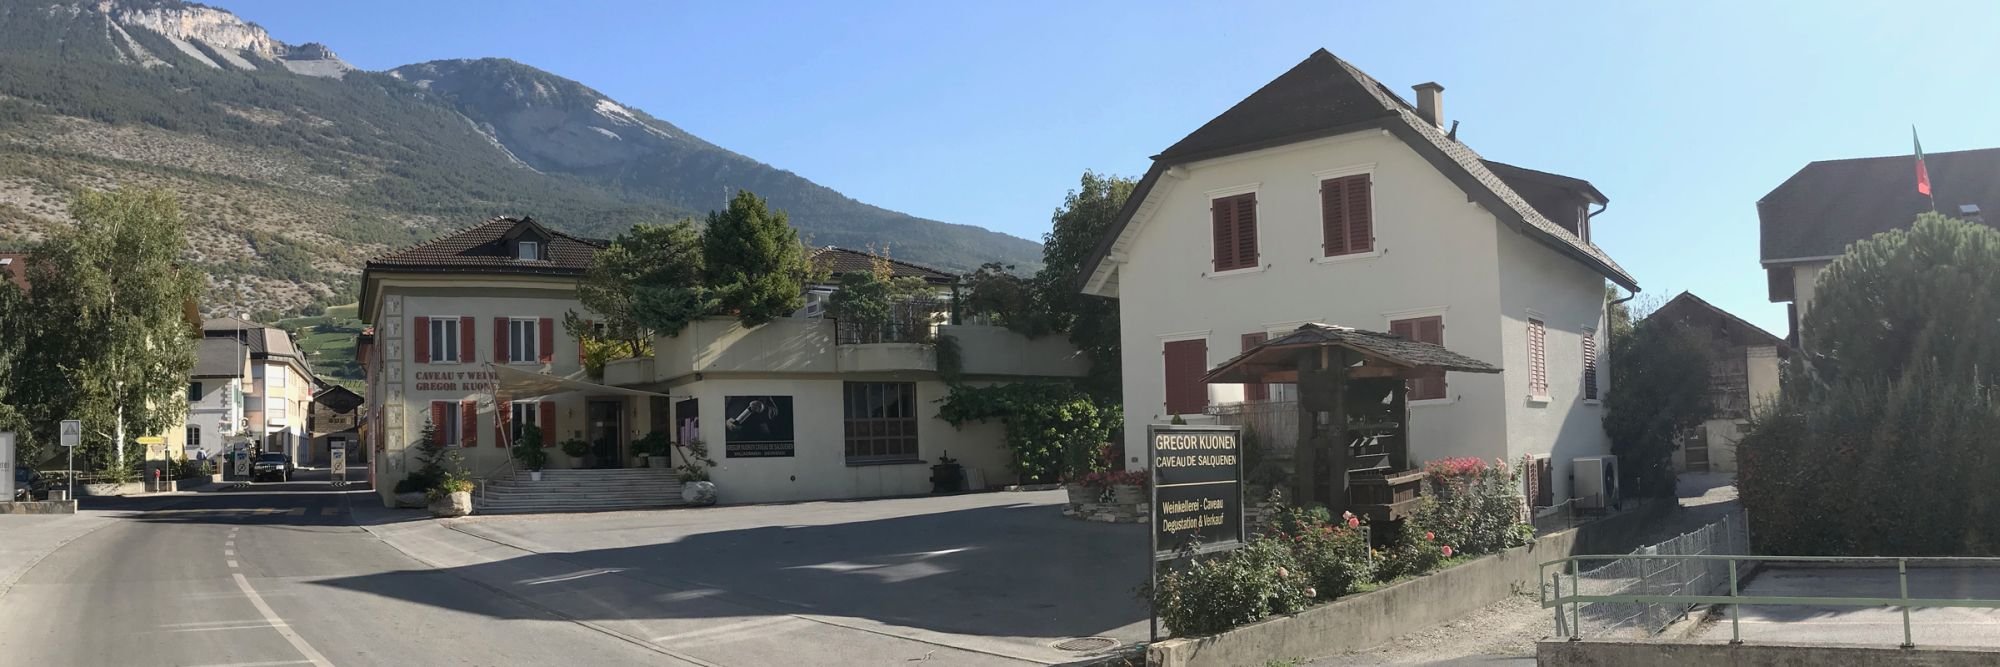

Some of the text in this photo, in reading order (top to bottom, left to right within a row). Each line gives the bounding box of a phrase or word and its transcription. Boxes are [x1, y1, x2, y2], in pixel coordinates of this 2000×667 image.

[415, 371, 454, 380] CAVEAU
[416, 382, 457, 391] GREGOR
[1155, 435, 1236, 450] GREGOR KUONEN
[1156, 455, 1237, 468] CAVEAU DE SALQUENEN
[1162, 498, 1199, 515] Weinkellerei
[1203, 497, 1224, 511] Caveau
[1162, 512, 1224, 534] Degustation & Verkauf
